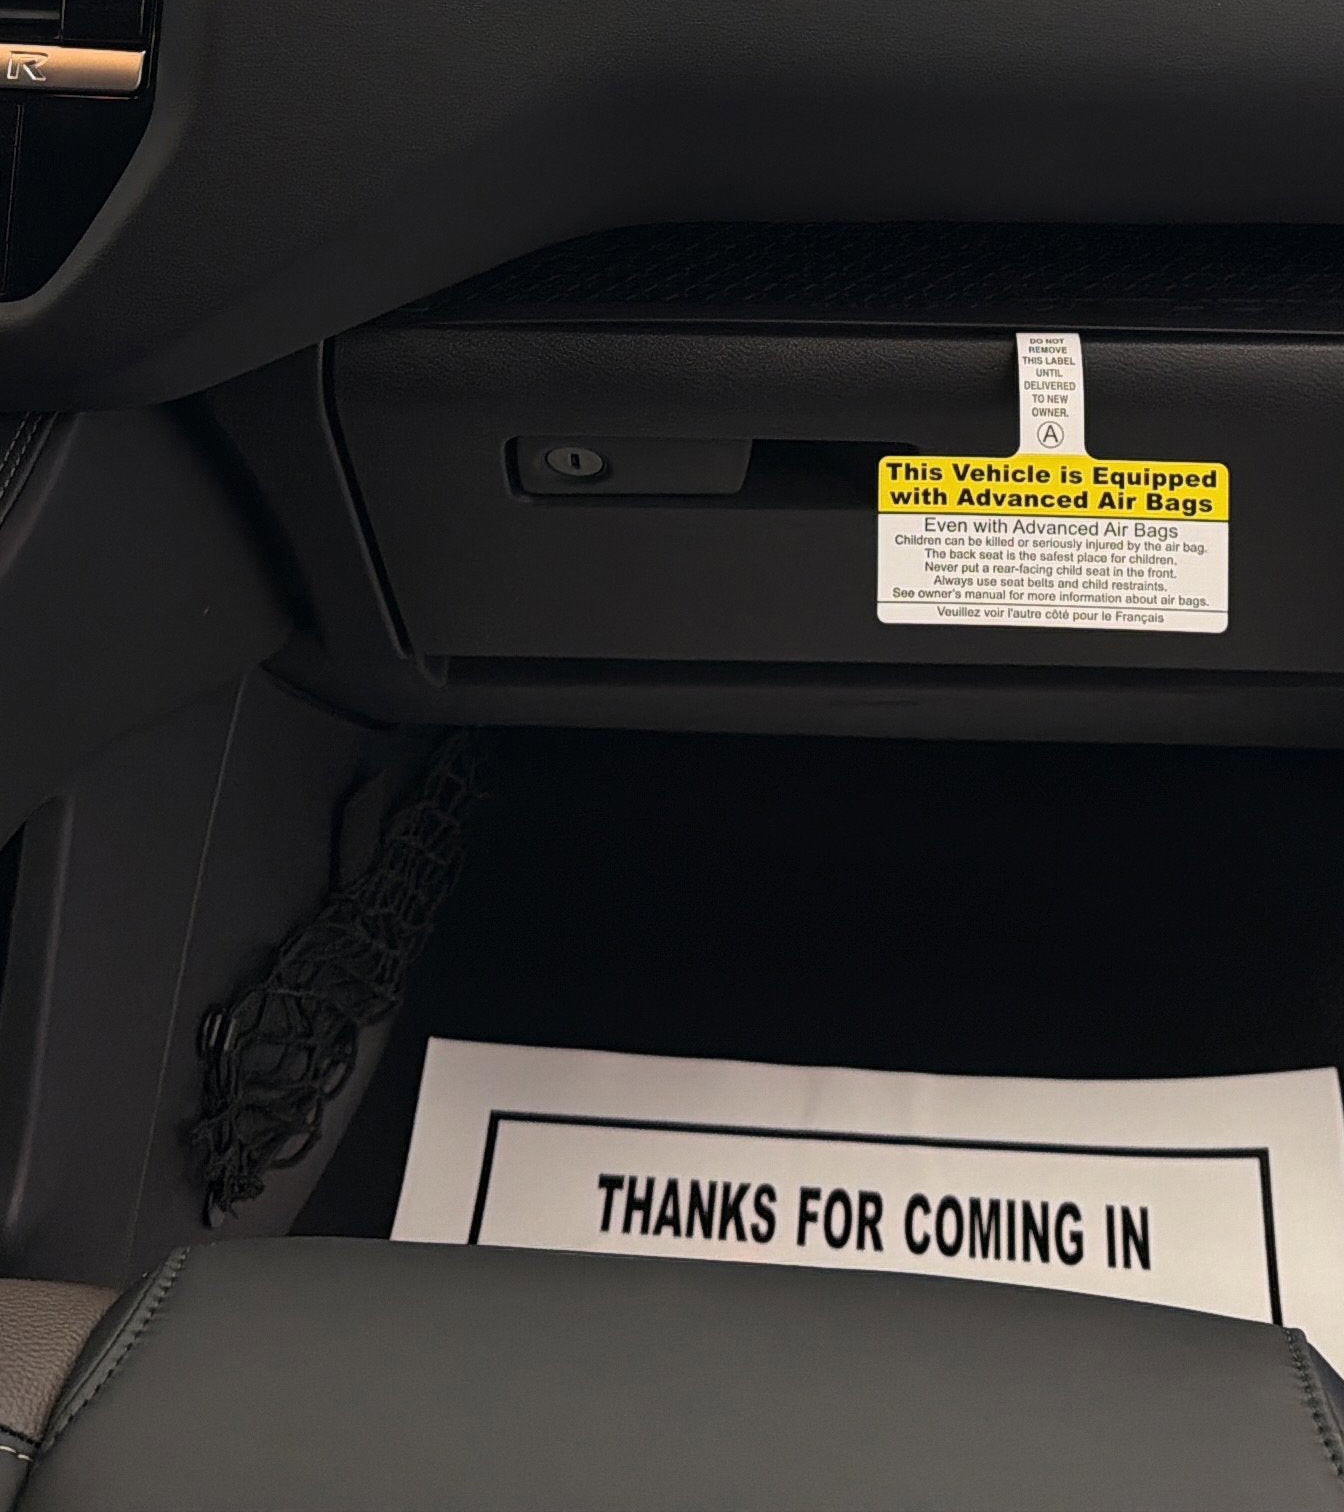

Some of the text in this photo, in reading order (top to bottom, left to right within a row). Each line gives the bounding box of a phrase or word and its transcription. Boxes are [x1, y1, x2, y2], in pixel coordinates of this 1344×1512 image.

[1028, 346, 1067, 354] REMOVE
[1022, 356, 1076, 365] THIS LABEL
[1036, 368, 1063, 377] UNTIL
[1023, 381, 1077, 391] DELIVERED
[1032, 394, 1069, 404] TO NEW
[1031, 407, 1069, 418] OWNER.
[1042, 424, 1059, 443] A
[886, 462, 1217, 492] This Vehicle is Equipped
[889, 487, 1213, 517] with Advanced Air Bags
[924, 517, 1179, 542] Even with Advanced Air Bags
[894, 534, 1208, 555] Children can be killed or seriously injured by the air bag.
[924, 548, 1177, 565] The back seat is the safest place for children.
[925, 561, 1177, 579] Never put a rear-facing child seat in the front.
[933, 575, 1168, 592] Always use seat belts and child restraints.
[892, 587, 1209, 608] See owner's manual for more information about air bags.
[937, 606, 1164, 624] Veuillez voir l'autre côté pour le Français
[597, 1172, 1152, 1271] THANKS FOR COMING IN
